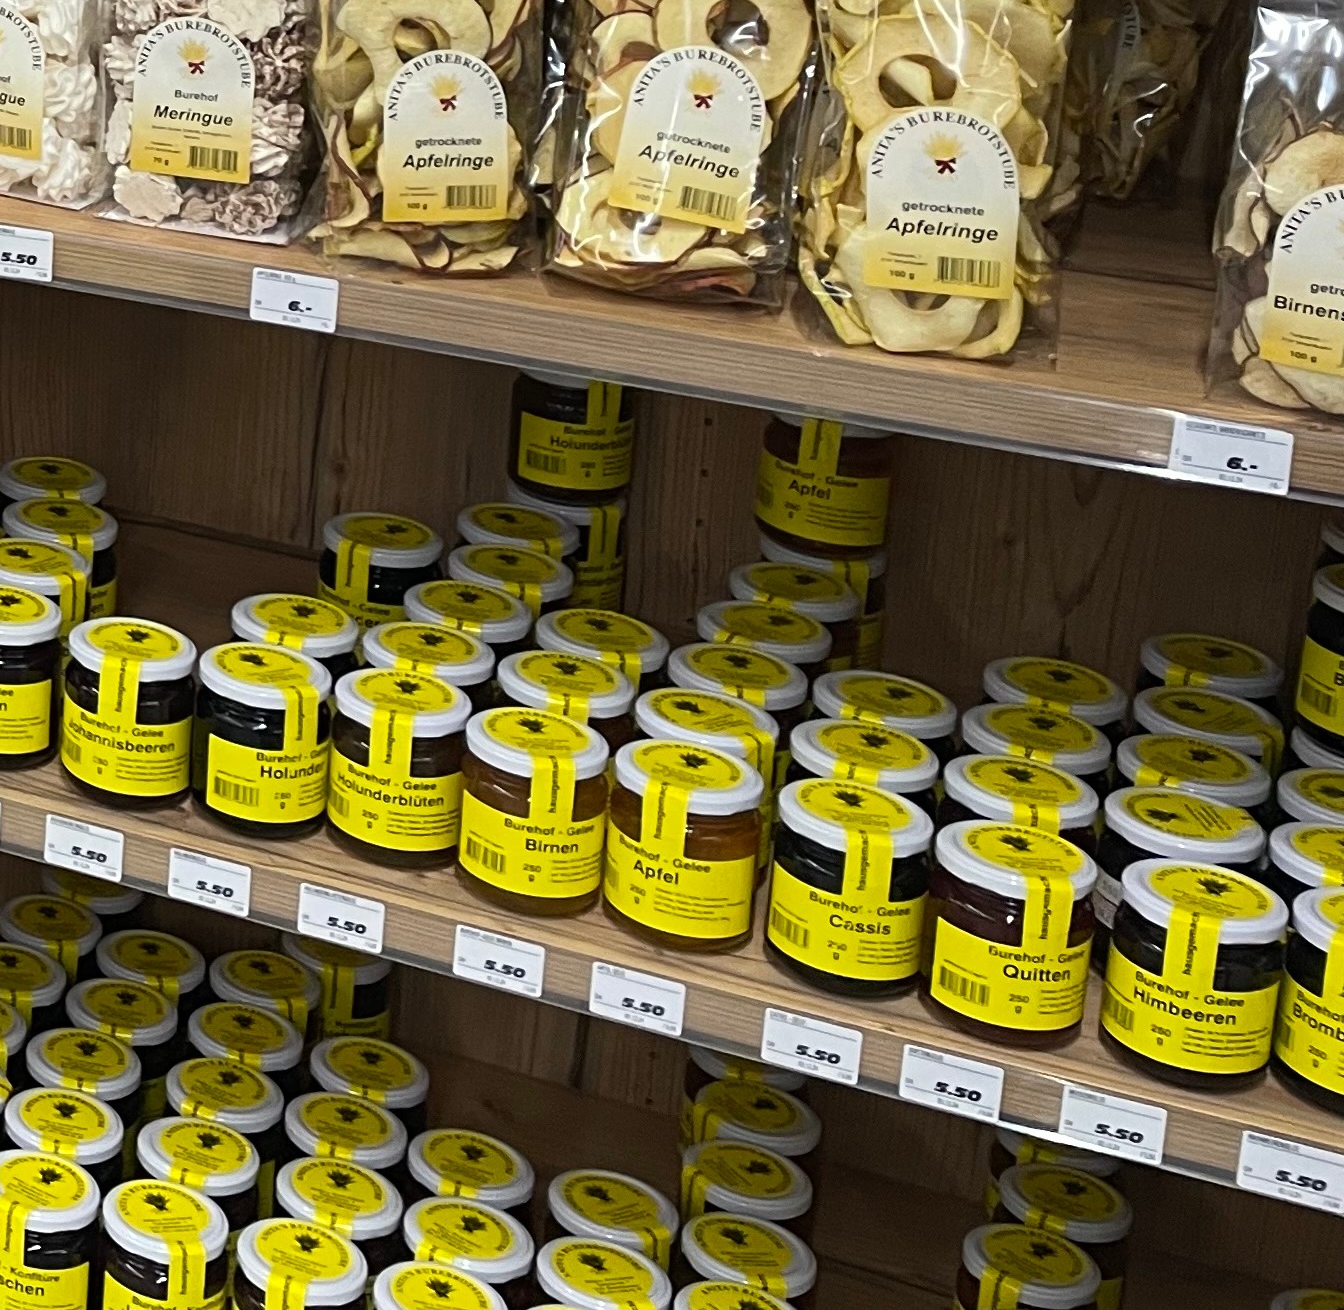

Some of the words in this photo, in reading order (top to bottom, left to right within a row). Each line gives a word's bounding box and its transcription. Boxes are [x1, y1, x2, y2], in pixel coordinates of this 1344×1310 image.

[165, 20, 252, 88] BUREBROTSTUBE
[174, 88, 219, 103] Burehof
[387, 68, 414, 122] ANITA'S
[414, 52, 505, 121] BUREBROTSTUBE
[672, 47, 763, 133] BUREBROTSTUBE
[153, 104, 234, 128] Meringue
[415, 137, 482, 149] getrocknete
[870, 124, 907, 179] ANITA'S
[907, 109, 1018, 191] BUREBROTSTUBE
[402, 153, 495, 170] Apfelringe
[637, 144, 740, 179] Apfelringe
[901, 200, 986, 217] getrocknete
[885, 216, 1000, 244] Apfelringe
[0, 251, 38, 266] 5.50
[287, 300, 313, 312] 6.-
[1226, 456, 1259, 472] 6.-
[504, 818, 557, 836] Burehof
[70, 845, 108, 864] 5.50
[524, 837, 580, 855] Birnen
[632, 859, 680, 888] Apfel
[195, 879, 234, 898] 5.50
[326, 915, 367, 935] 5.50
[828, 913, 892, 937] Cassis
[988, 944, 1046, 964] Burehof
[483, 958, 526, 979] 5.50
[1002, 963, 1072, 984] Quitten
[1134, 969, 1190, 1003] Burehof
[1203, 994, 1245, 1010] Gelee
[621, 996, 665, 1017] 5.50
[1133, 986, 1238, 1028] Himbeeren
[795, 1042, 841, 1065] 5.50
[933, 1080, 982, 1103] 5.50
[1094, 1121, 1144, 1145] 5.50
[1274, 1168, 1328, 1191] 5.50
